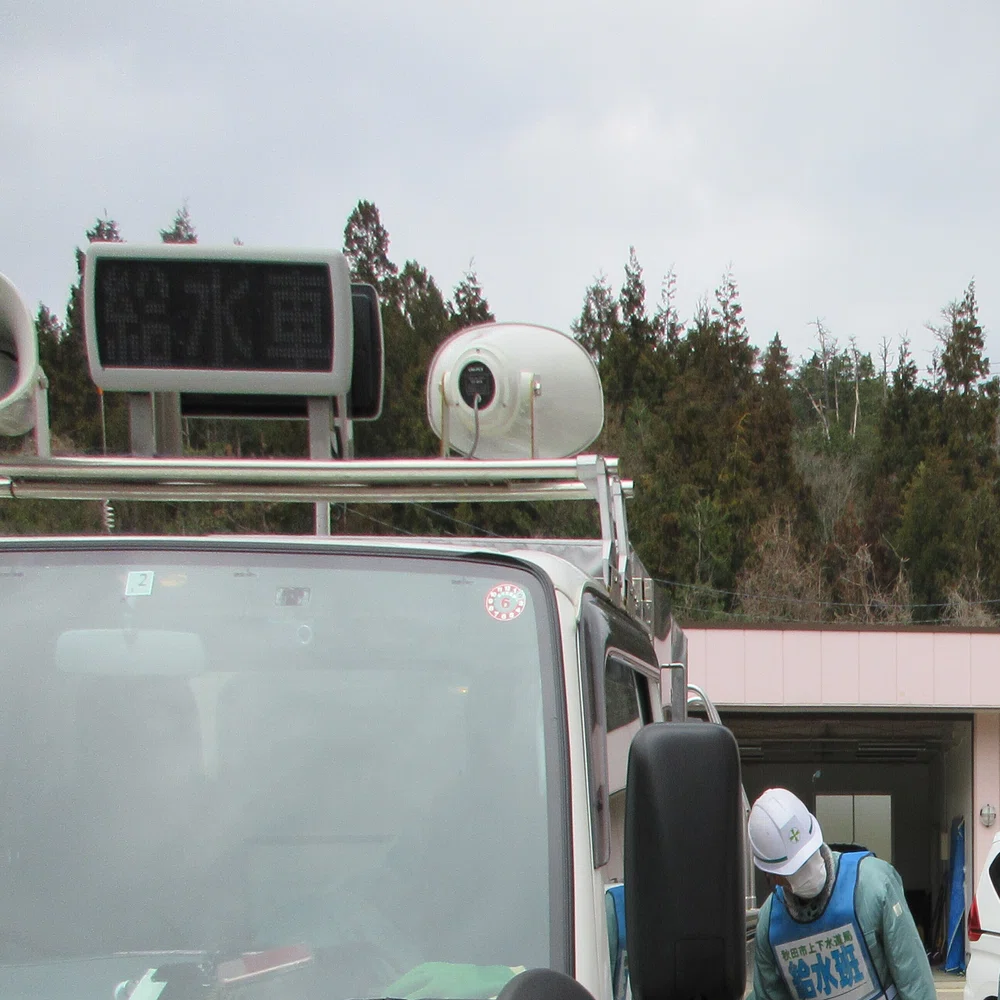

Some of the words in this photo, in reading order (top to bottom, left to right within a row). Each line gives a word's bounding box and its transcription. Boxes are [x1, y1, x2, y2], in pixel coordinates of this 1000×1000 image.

[103, 265, 329, 368] 給水車
[138, 573, 148, 586] 2
[781, 930, 853, 961] 秋田市上下水道局
[788, 944, 864, 1000] 給水班
